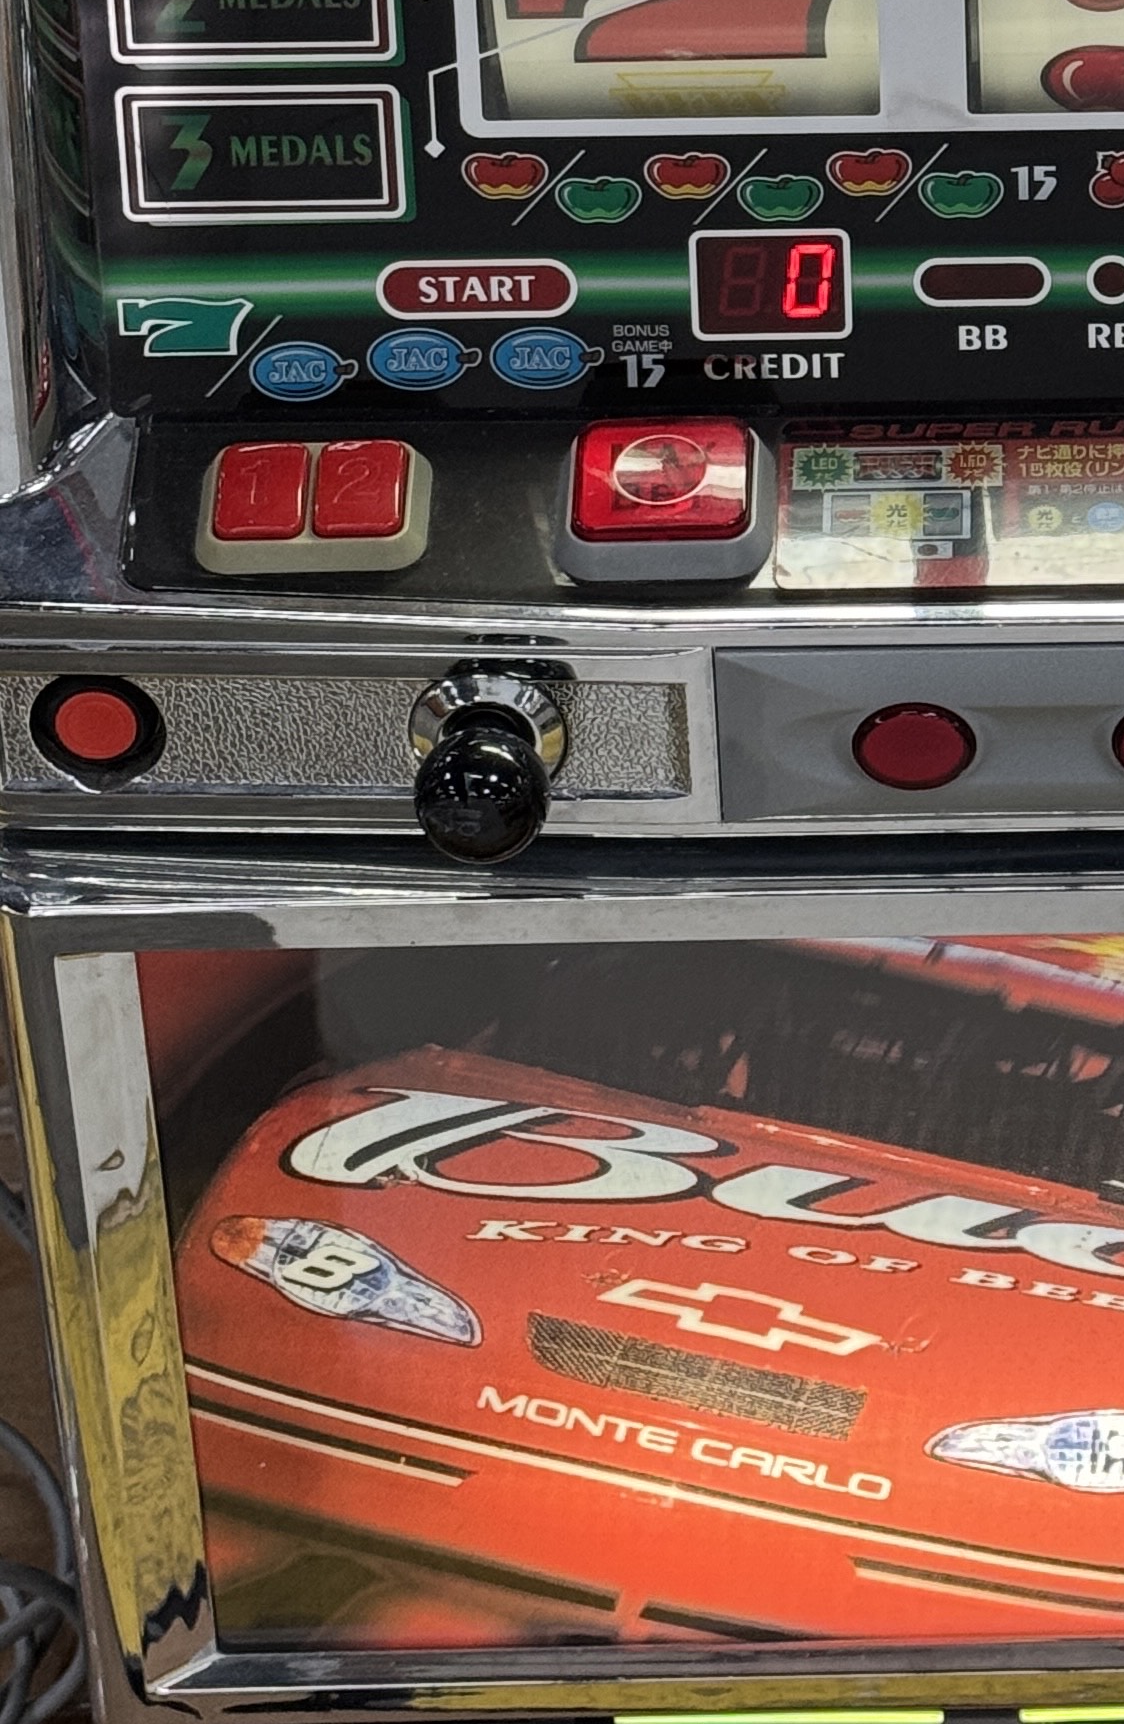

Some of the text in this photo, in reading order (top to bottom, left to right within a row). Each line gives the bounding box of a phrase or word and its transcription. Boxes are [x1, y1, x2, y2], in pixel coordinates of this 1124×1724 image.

[159, 114, 373, 190] 3 MEDALS
[1011, 165, 1057, 202] 15
[418, 276, 535, 302] START
[783, 243, 836, 319] 0
[612, 324, 670, 337] BONUS
[958, 326, 1008, 351] BB
[269, 347, 572, 383] JAC JAC JAC
[619, 356, 665, 388] 15
[703, 353, 844, 381] CREDIT
[850, 421, 1034, 439] SUPER
[811, 457, 838, 469] LED
[466, 1218, 750, 1255] KING
[787, 1244, 921, 1275] OF
[476, 1385, 893, 1501] MONTE CARLO
